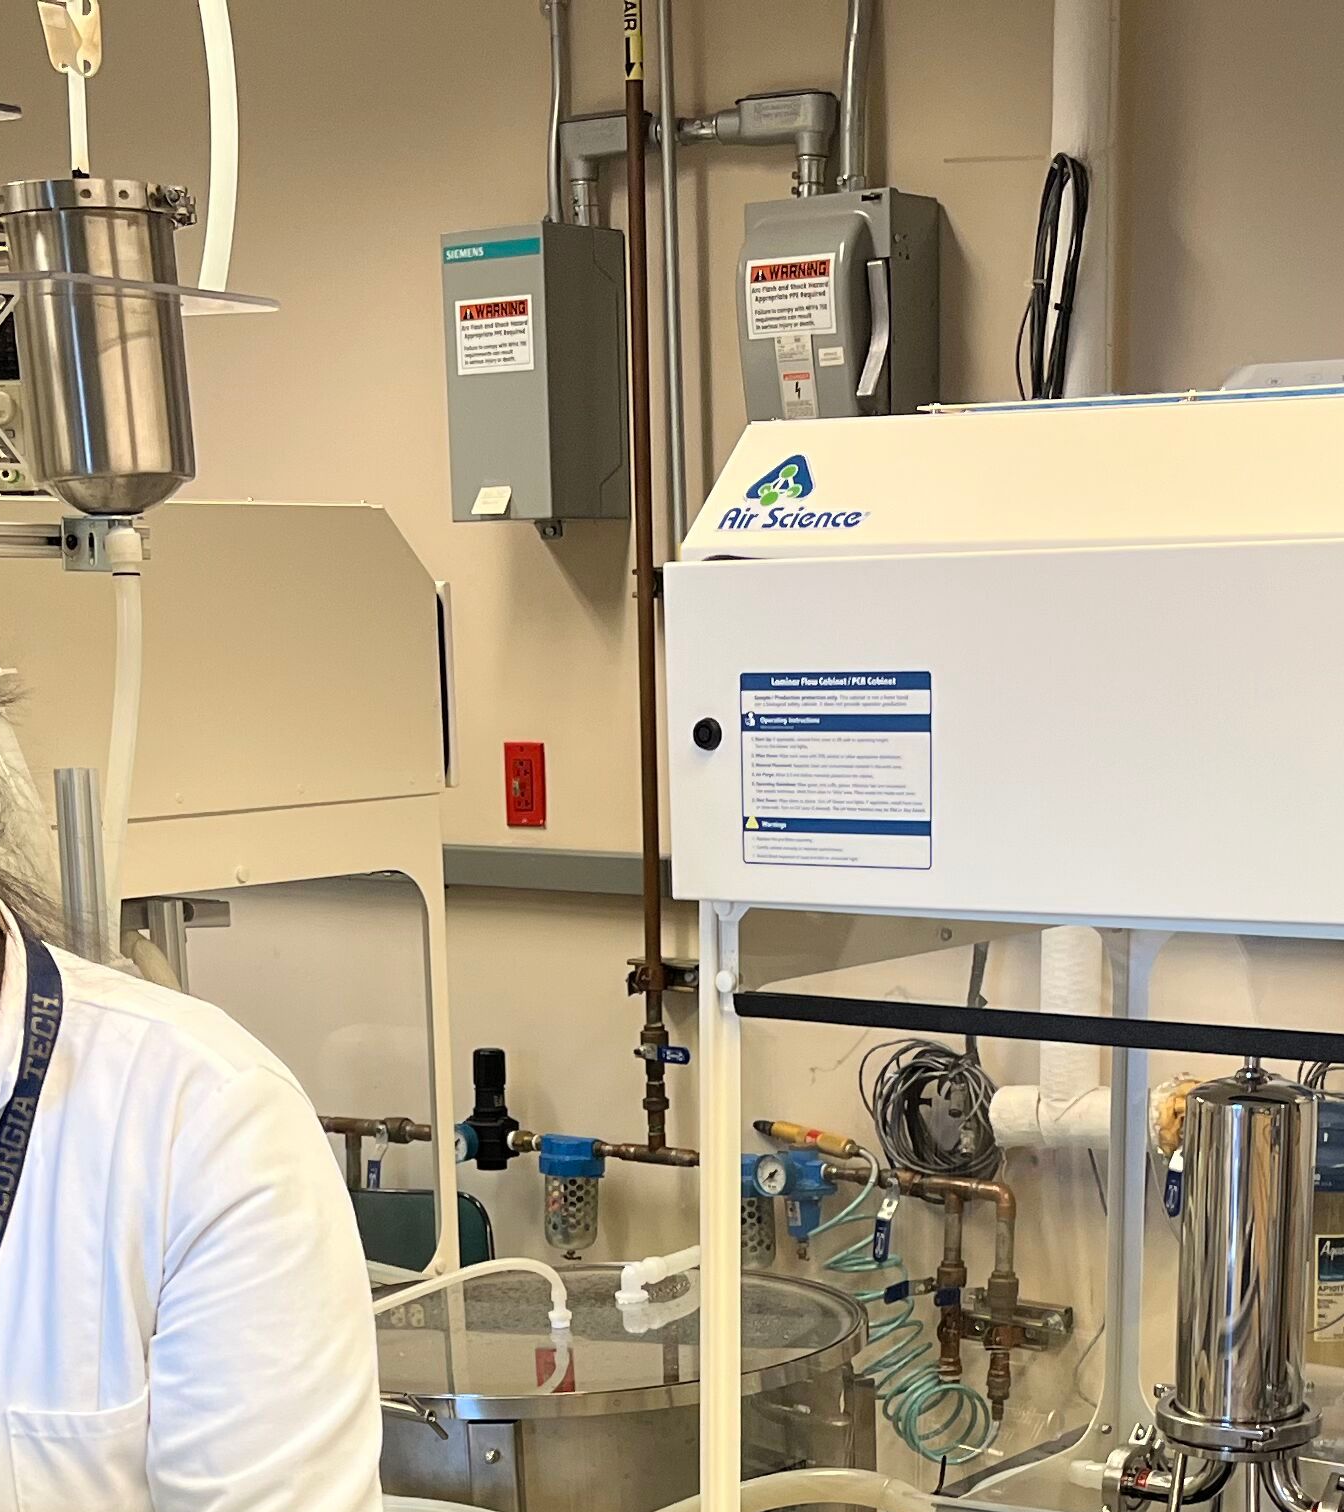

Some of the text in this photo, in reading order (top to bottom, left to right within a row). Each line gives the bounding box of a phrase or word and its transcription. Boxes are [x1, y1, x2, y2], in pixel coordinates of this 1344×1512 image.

[446, 247, 484, 260] SIEMENS
[770, 261, 826, 280] WARNING
[476, 301, 526, 318] WARNING
[719, 507, 862, 529] Air Science
[771, 677, 800, 687] Laminar
[801, 677, 818, 687] Flow
[819, 677, 847, 686] Cabinet
[867, 677, 896, 686] Cabinet
[760, 717, 787, 725] Operating
[24, 993, 59, 1082] TECH
